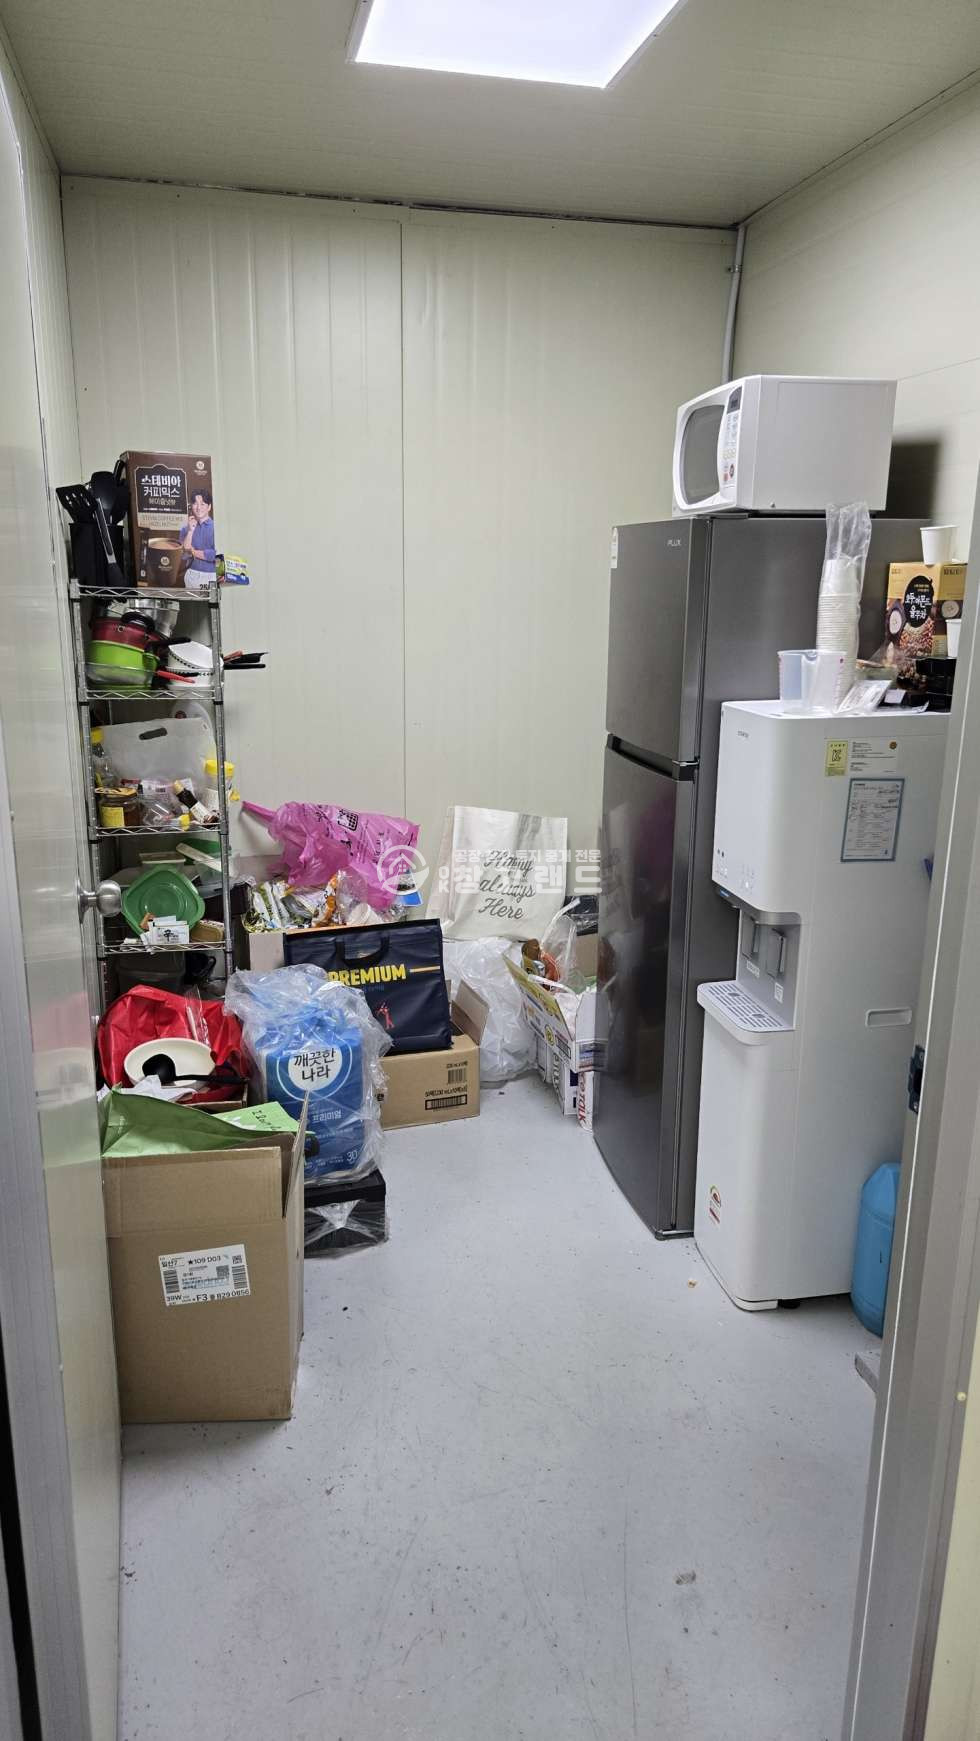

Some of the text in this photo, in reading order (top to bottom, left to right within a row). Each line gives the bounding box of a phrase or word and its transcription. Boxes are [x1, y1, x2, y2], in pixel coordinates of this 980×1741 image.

[140, 475, 181, 487] 스테비아
[143, 486, 180, 498] 커피믹스
[478, 897, 525, 920] Here
[328, 963, 407, 987] PREMIUM
[294, 1048, 336, 1066] 깨끗한
[302, 1064, 331, 1082] 나라
